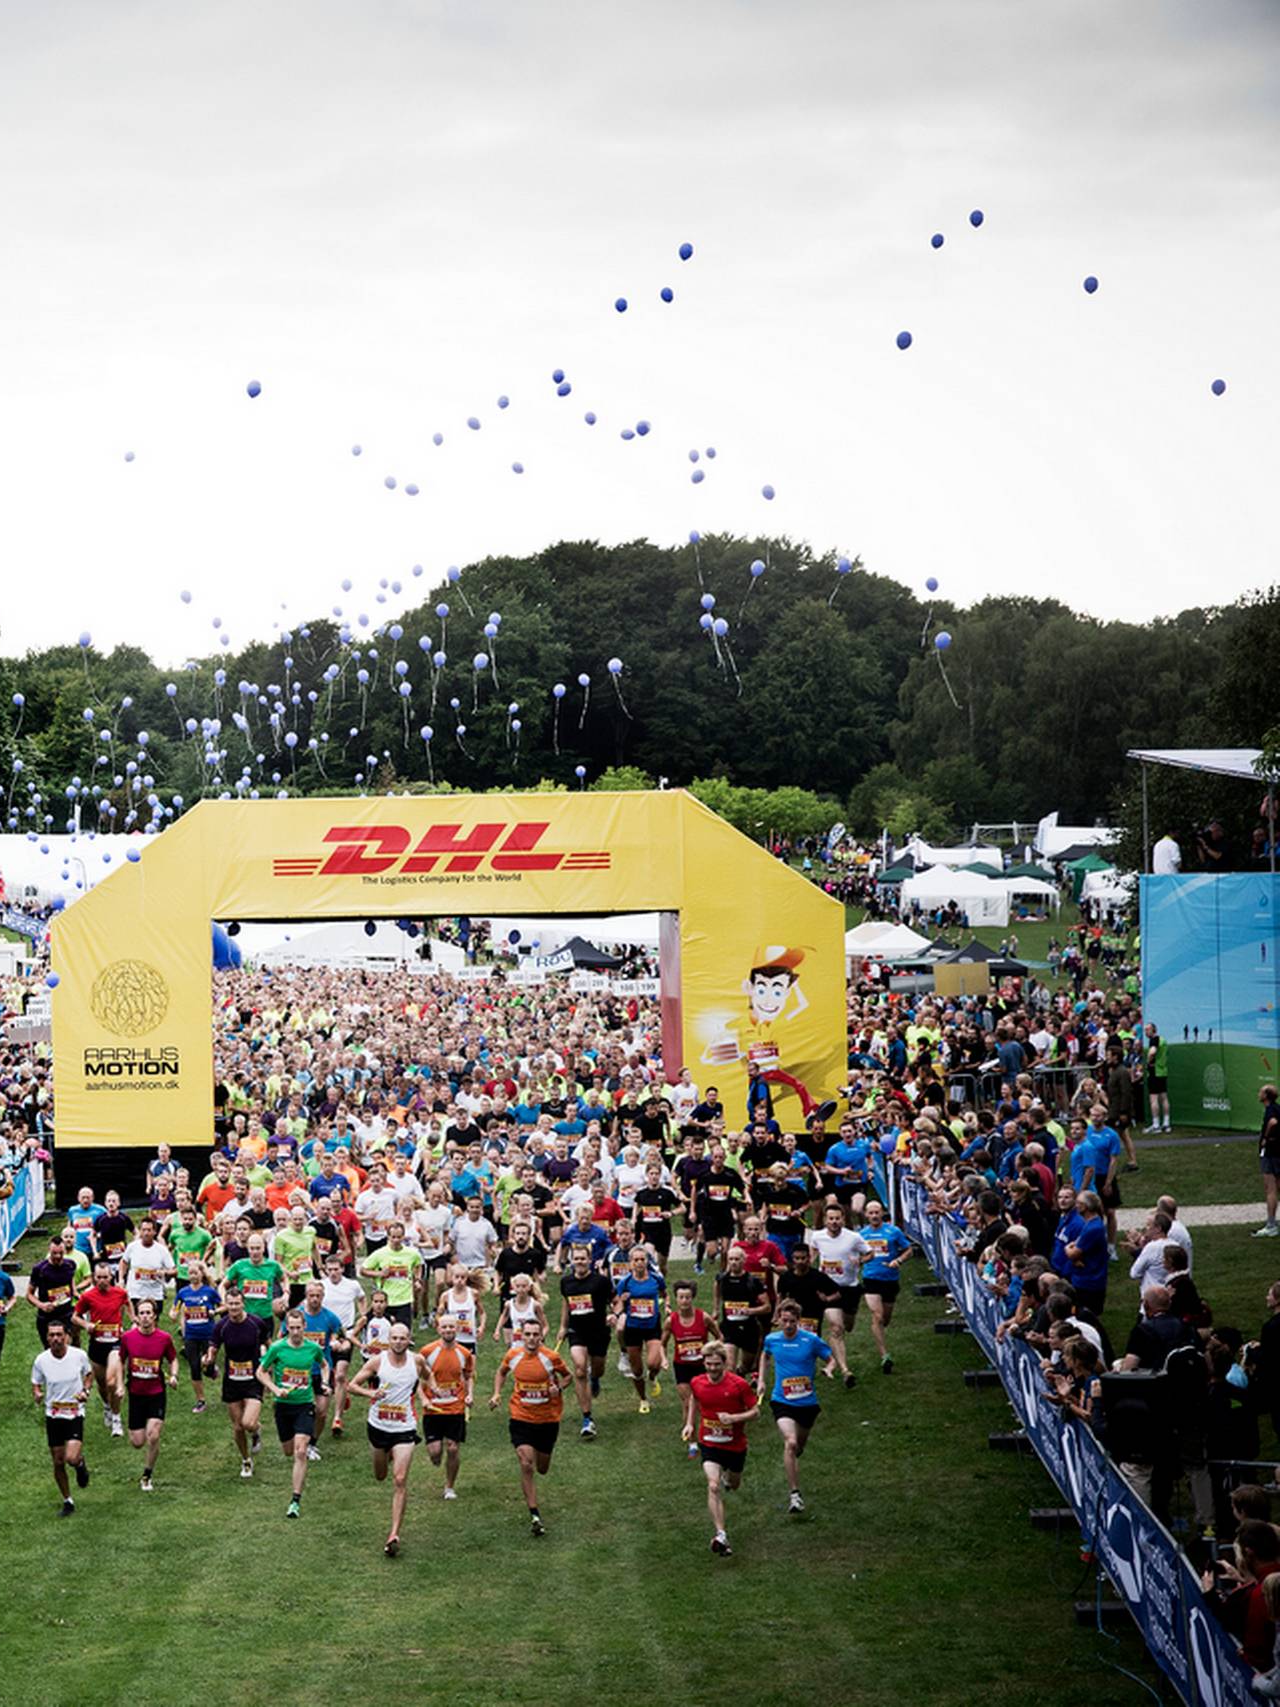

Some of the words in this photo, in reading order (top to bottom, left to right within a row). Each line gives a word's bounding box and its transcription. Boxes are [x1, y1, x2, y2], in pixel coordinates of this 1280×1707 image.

[318, 822, 567, 875] DHL
[362, 876, 378, 885] The
[380, 875, 417, 885] Logistics
[419, 874, 460, 884] Company
[462, 873, 475, 882] for
[477, 873, 492, 882] the
[494, 872, 522, 882] World
[84, 1046, 180, 1061] AARHUS
[84, 1061, 179, 1076] MOTION
[85, 1079, 180, 1091] aarhusmotion.dk
